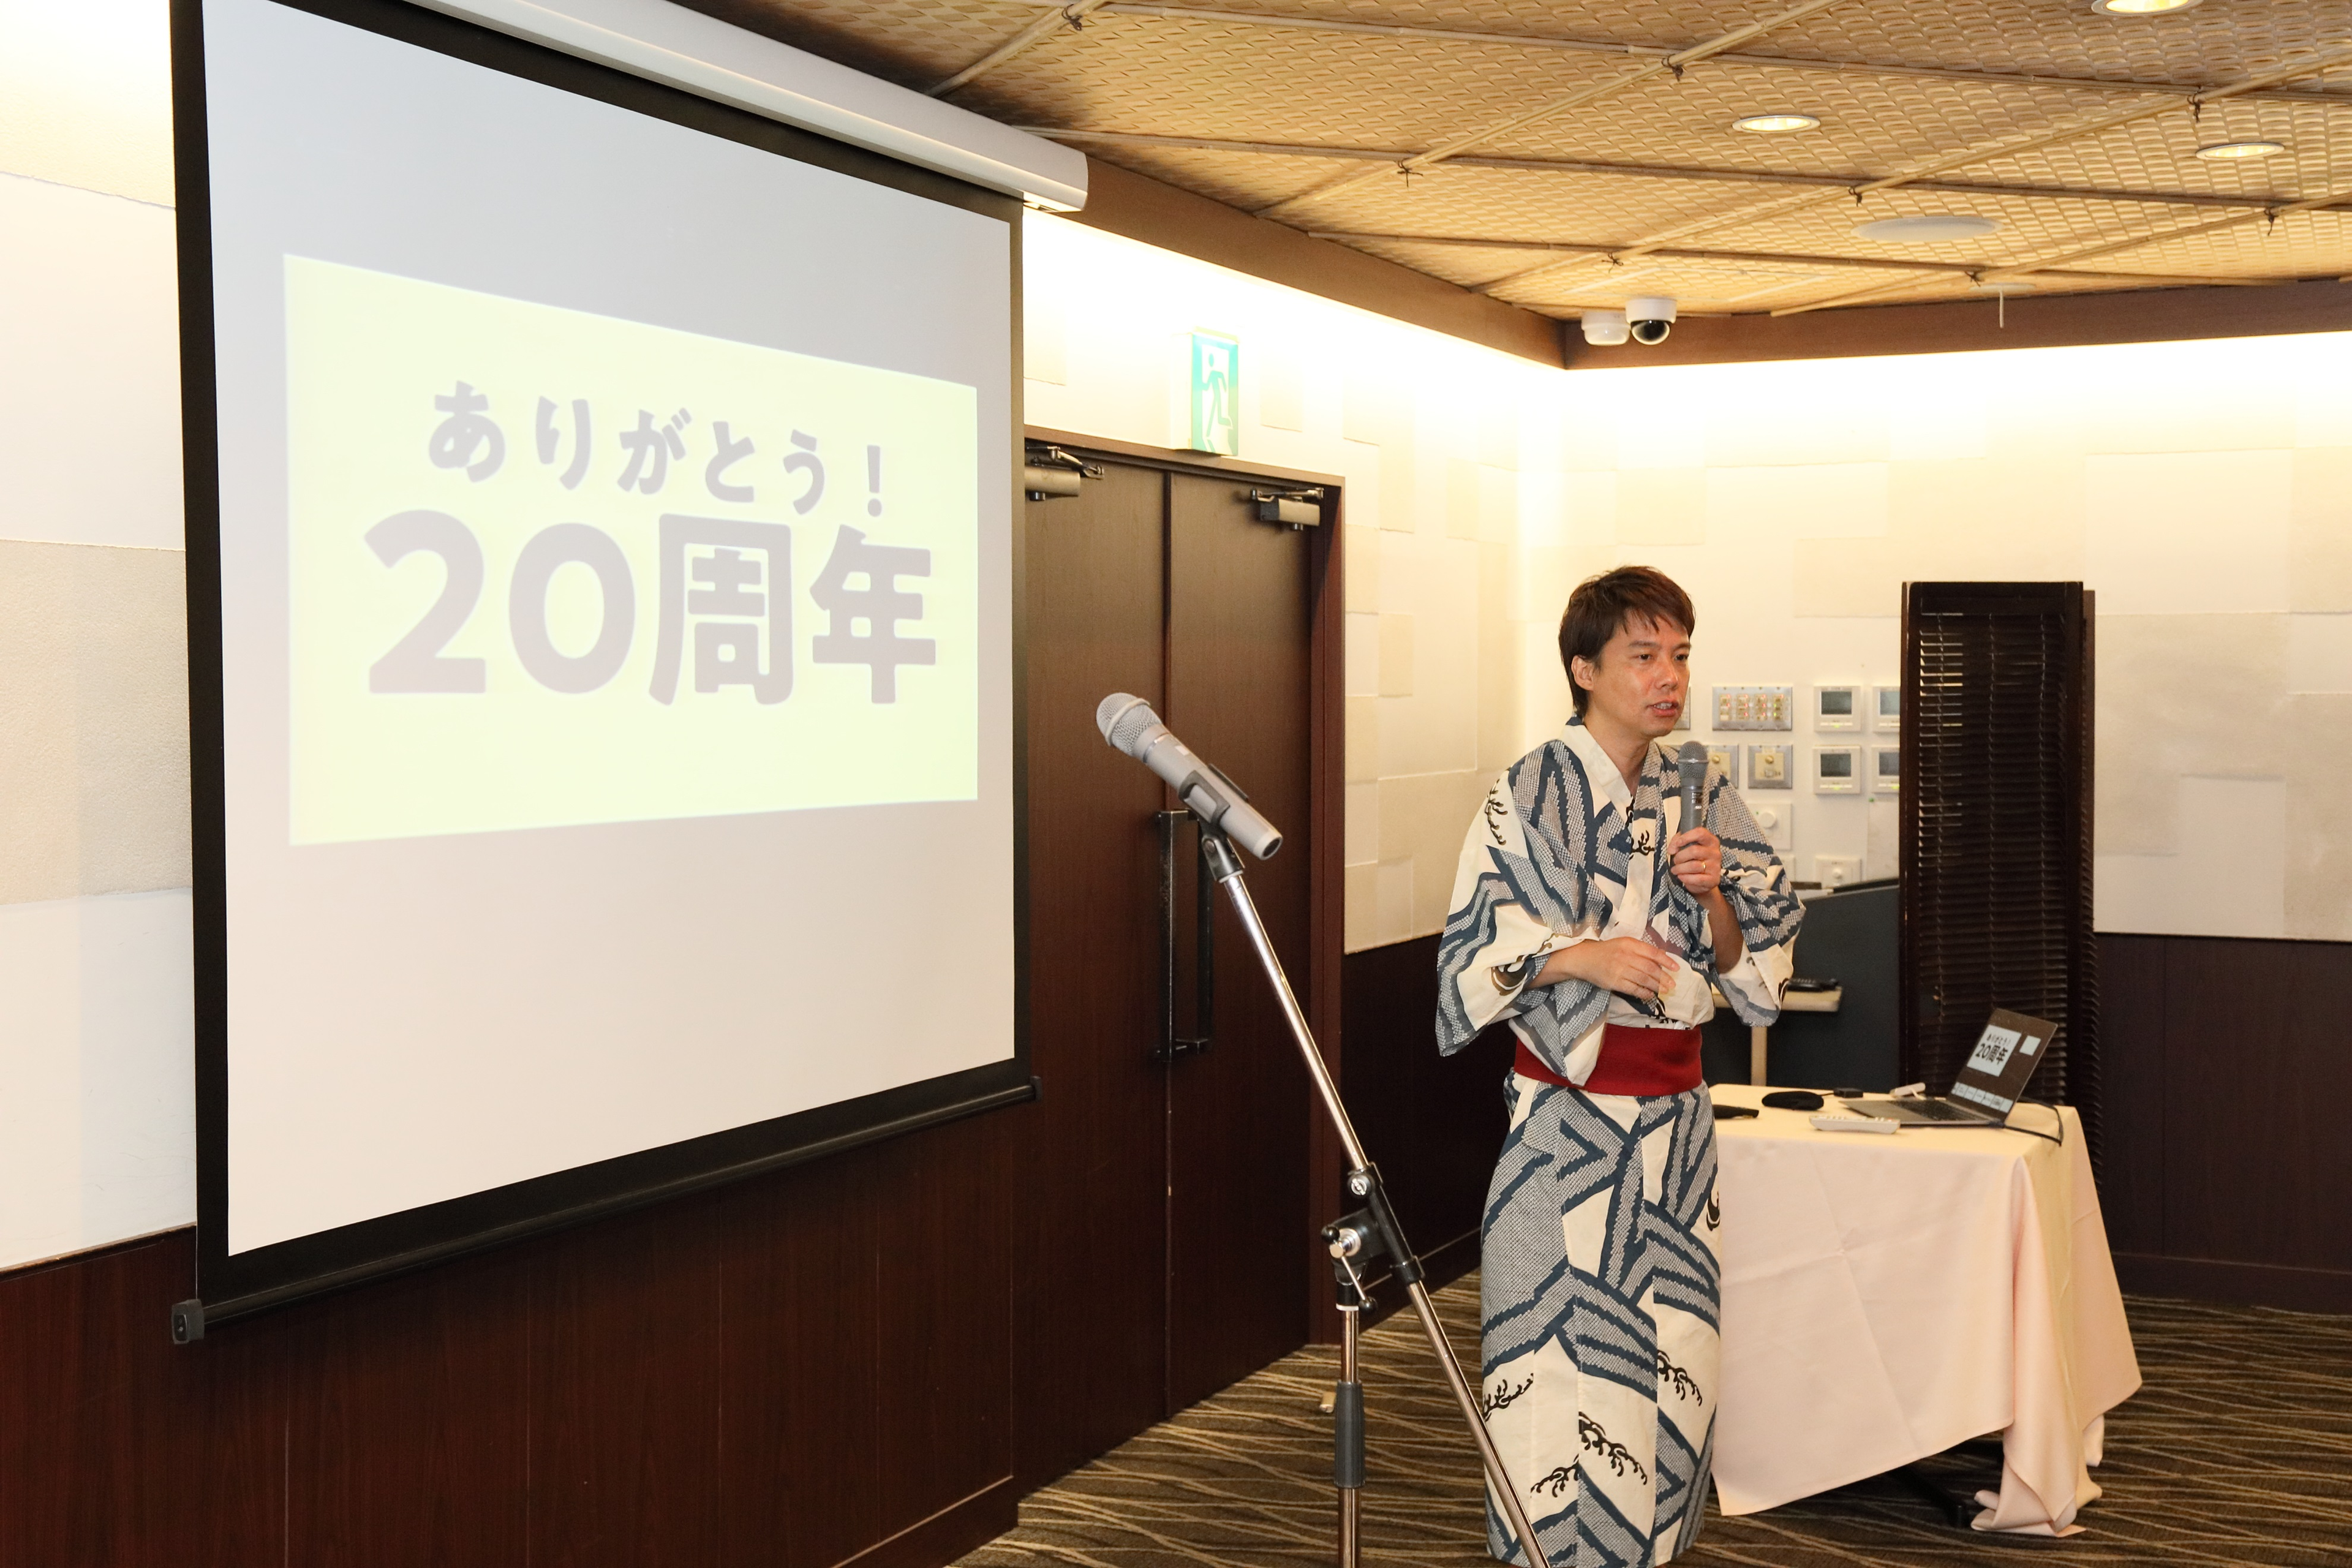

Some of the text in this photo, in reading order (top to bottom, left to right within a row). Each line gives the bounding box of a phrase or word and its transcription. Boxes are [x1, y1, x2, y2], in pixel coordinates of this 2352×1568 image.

[428, 380, 885, 518] ありがとう！
[363, 509, 937, 707] 20周年
[1975, 1042, 2008, 1065] 20周年
